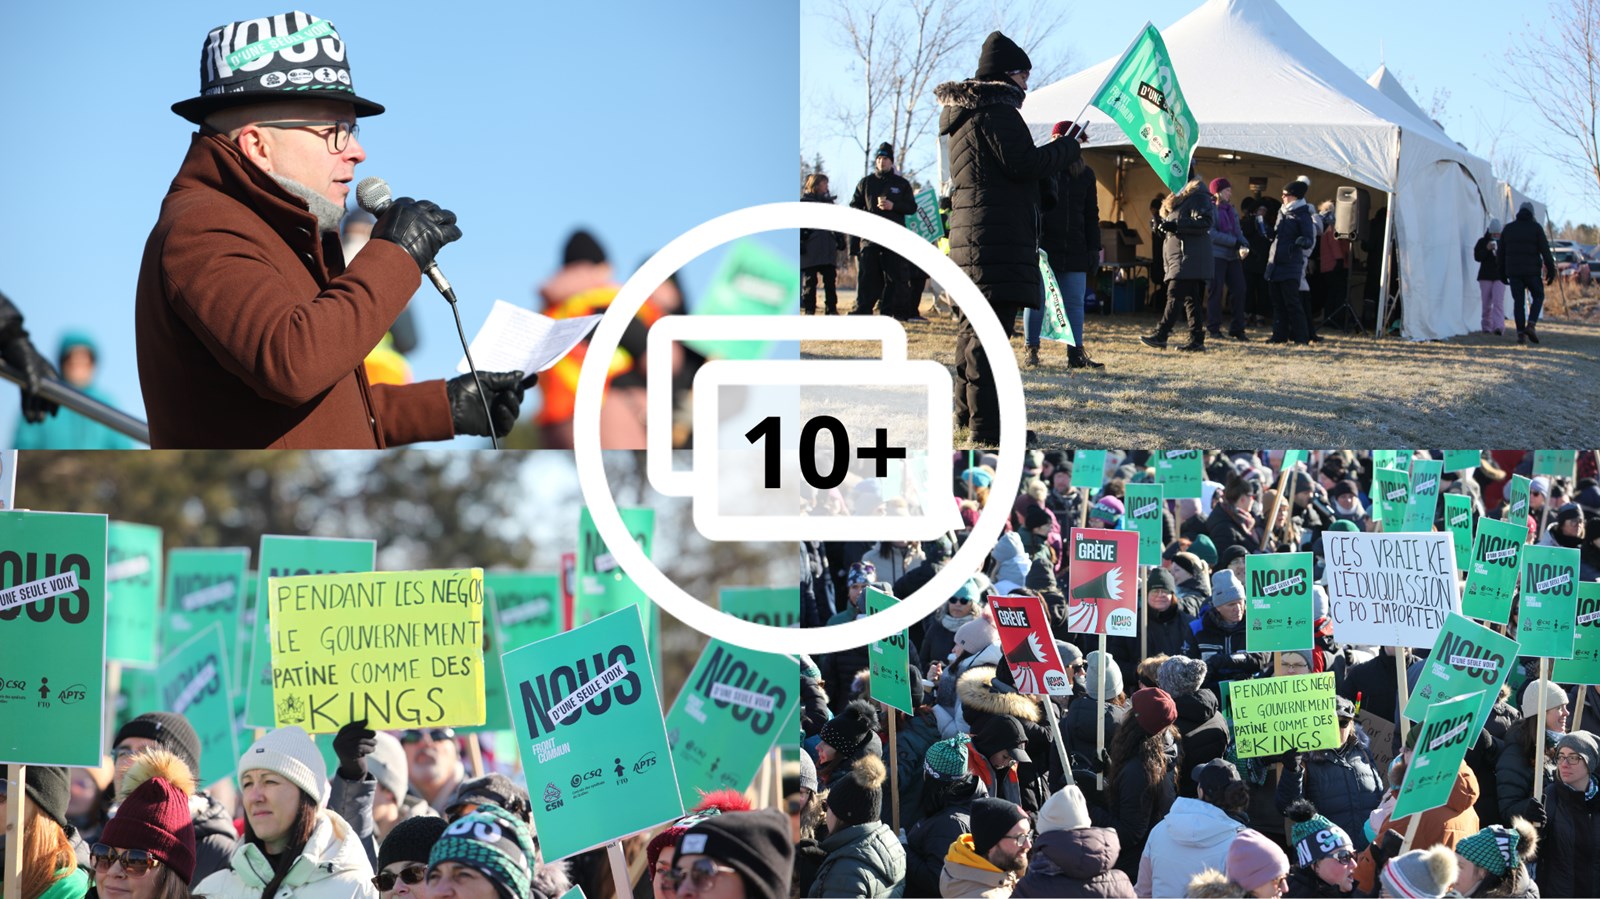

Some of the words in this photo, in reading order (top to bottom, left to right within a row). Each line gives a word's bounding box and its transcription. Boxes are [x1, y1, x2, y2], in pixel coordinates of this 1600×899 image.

[1140, 84, 1163, 105] D'UNE
[1076, 533, 1084, 541] EN
[1078, 540, 1114, 561] GRÈVE
[1330, 536, 1362, 568] CES
[1370, 539, 1423, 572] VRAIE
[1425, 540, 1449, 576] KE
[1476, 533, 1520, 569] NOUS
[19, 582, 48, 601] SEULE
[50, 575, 74, 592] VOIX
[1252, 568, 1307, 597] NOUS
[1333, 568, 1452, 611] L'ÉDUQUASSION
[1525, 562, 1575, 597] NOUS
[278, 581, 386, 612] PENDANT
[395, 581, 425, 607] LES
[431, 573, 484, 608] NÉGOS
[997, 607, 1028, 627] GRÈVE
[1111, 614, 1131, 627] NOUS
[1333, 601, 1345, 625] C
[1349, 601, 1367, 622] PO
[278, 629, 300, 653] LE
[320, 621, 480, 656] GOUVERNEMENT
[351, 659, 420, 684] COMME
[432, 656, 471, 678] DES
[1435, 631, 1505, 685] NOUS
[6, 680, 26, 691] CSQ
[519, 644, 642, 740] NOUS
[552, 697, 577, 721] D'UNE
[576, 679, 603, 703] SEULE
[601, 665, 624, 685] VOIX
[694, 645, 787, 736] NOUS
[1046, 676, 1065, 687] NOUS
[1233, 680, 1288, 699] PENDANT
[1293, 679, 1308, 693] LES
[58, 690, 86, 701] APTS
[309, 687, 445, 730] KINGS
[1235, 706, 1248, 720] LE
[1257, 697, 1335, 719] GOUVERNEMENT
[1273, 717, 1309, 732] COMME
[1313, 714, 1333, 727] DES
[1419, 711, 1473, 755] NOUS
[532, 737, 555, 756] FRONT
[538, 742, 571, 764] COMMUN
[1253, 730, 1321, 755] KINGS
[583, 768, 602, 781] CSQ
[633, 756, 656, 772] APTS
[545, 800, 564, 813] CSN
